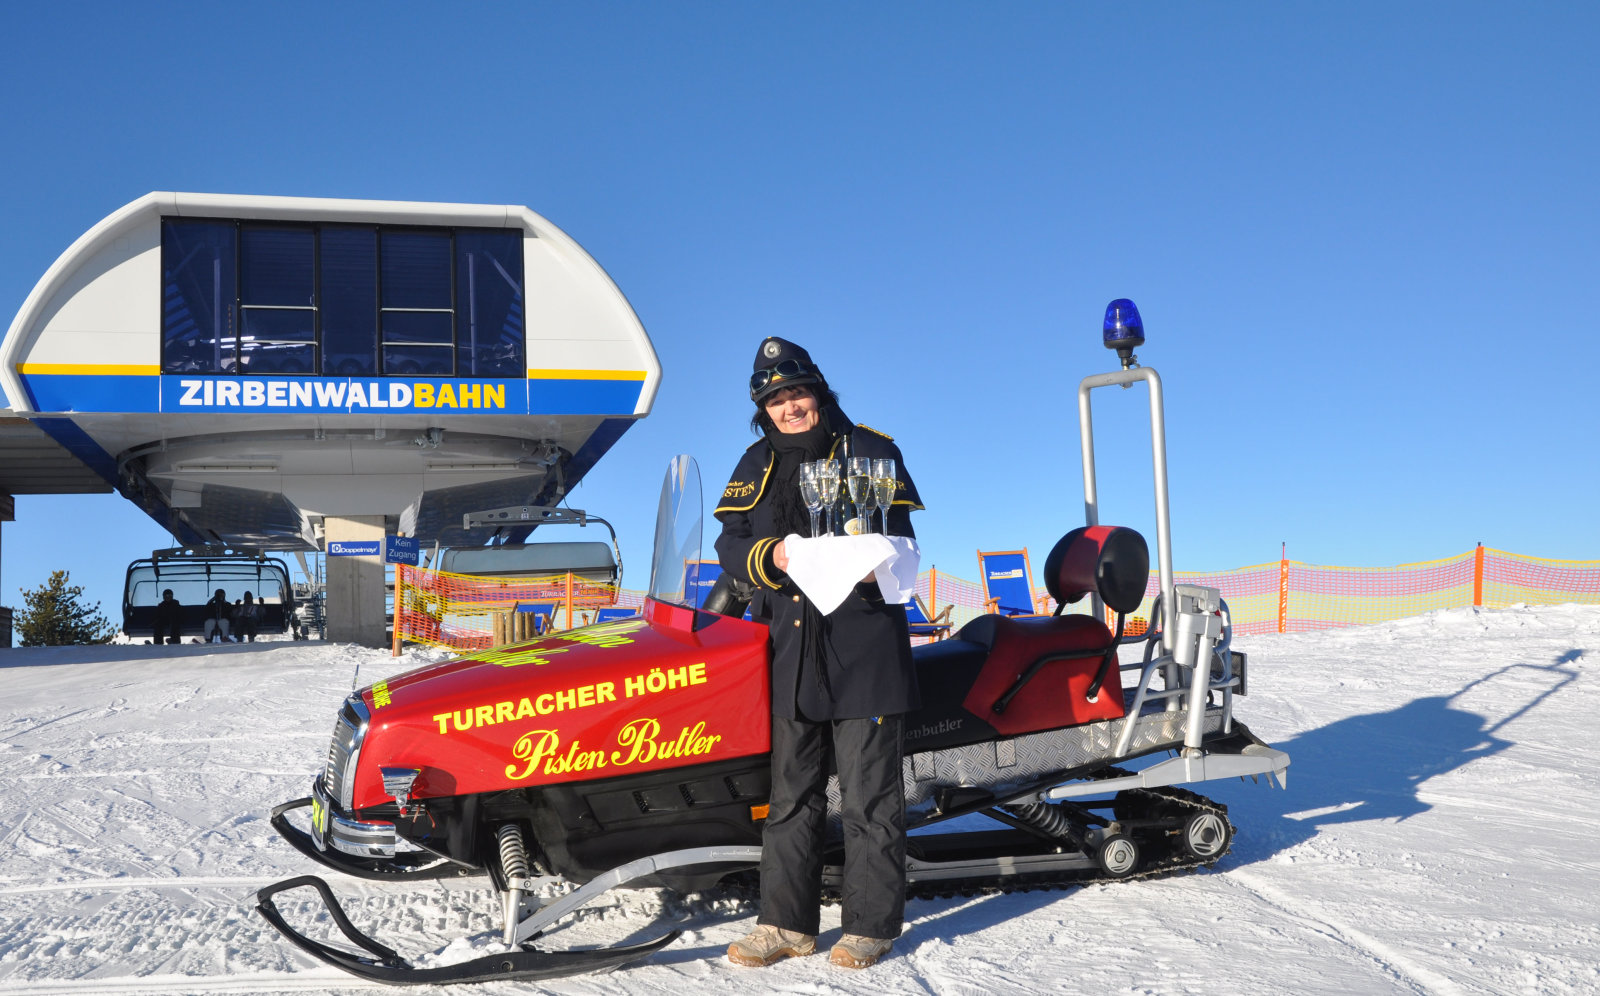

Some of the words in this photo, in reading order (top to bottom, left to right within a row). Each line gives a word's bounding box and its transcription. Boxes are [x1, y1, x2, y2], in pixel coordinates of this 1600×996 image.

[179, 379, 507, 410] ZIRBENWALDBAHN
[341, 546, 378, 554] Doppelmayr
[395, 538, 412, 547] Kein
[389, 549, 417, 561] Zugang
[432, 681, 617, 735] TURRACHER
[624, 661, 708, 699] HÖHE
[905, 718, 964, 740] enbutler
[504, 728, 610, 781] Pisten
[610, 717, 722, 767] Butler
